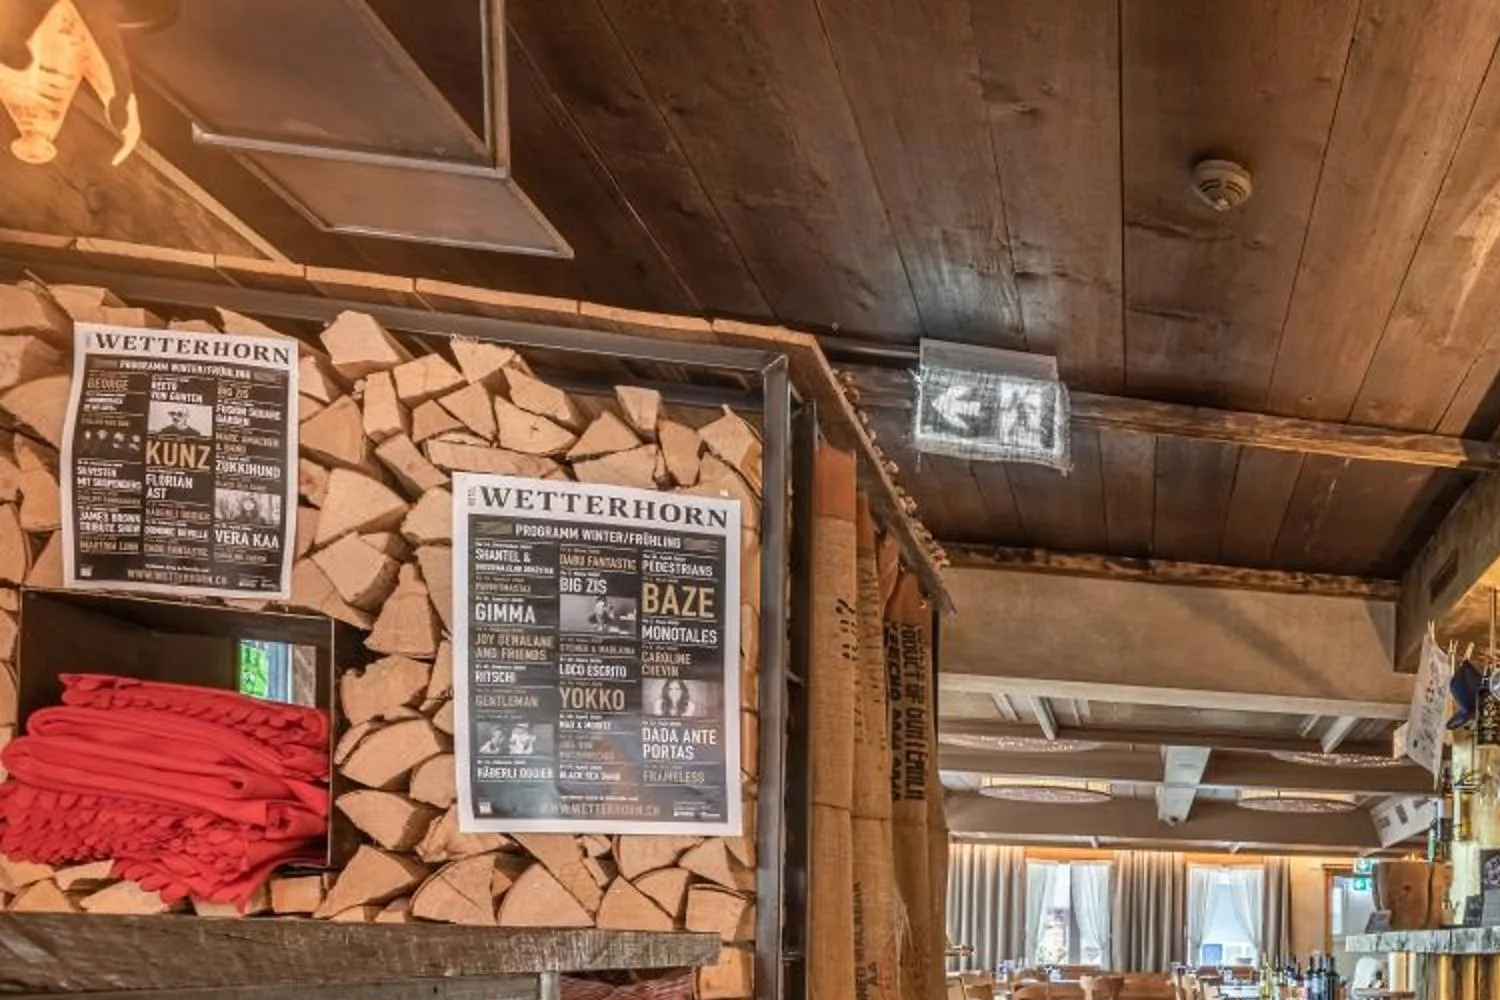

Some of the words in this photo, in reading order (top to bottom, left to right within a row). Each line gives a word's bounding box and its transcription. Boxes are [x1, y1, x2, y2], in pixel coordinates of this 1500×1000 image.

[96, 332, 290, 365] WETTERHORN
[145, 440, 212, 471] KUNZ
[215, 459, 282, 479] ZUKKIHUND
[145, 473, 194, 489] FLORIAN
[145, 487, 168, 500] AST
[479, 485, 729, 530] WETTERHORN
[214, 529, 250, 546] VERA
[252, 532, 280, 549] KAA
[514, 522, 579, 541] PROGRAMM
[581, 527, 682, 550] WINTER/FRÜHLING
[474, 548, 522, 564] SHANTEL
[586, 555, 638, 571] FANTASTIC
[641, 559, 714, 578] PEDESTRIANS
[559, 577, 582, 592] BIG
[585, 578, 608, 594] ZIS
[641, 582, 716, 619] BAZE
[474, 602, 537, 625] GIMMA
[474, 632, 495, 647] JOY
[641, 624, 718, 645] MONOTALES
[474, 647, 498, 660] AND
[500, 648, 547, 661] FRIENDS
[641, 650, 693, 666] CAROLINE
[559, 663, 586, 676] LOCO
[586, 664, 628, 679] ESCRITO
[474, 694, 539, 708] GENTLEMAN
[559, 687, 626, 711] YOKKO
[641, 727, 679, 745] DADA
[682, 728, 718, 746] ANTE
[642, 743, 696, 761] PORTAS
[866, 961, 879, 987] AA
